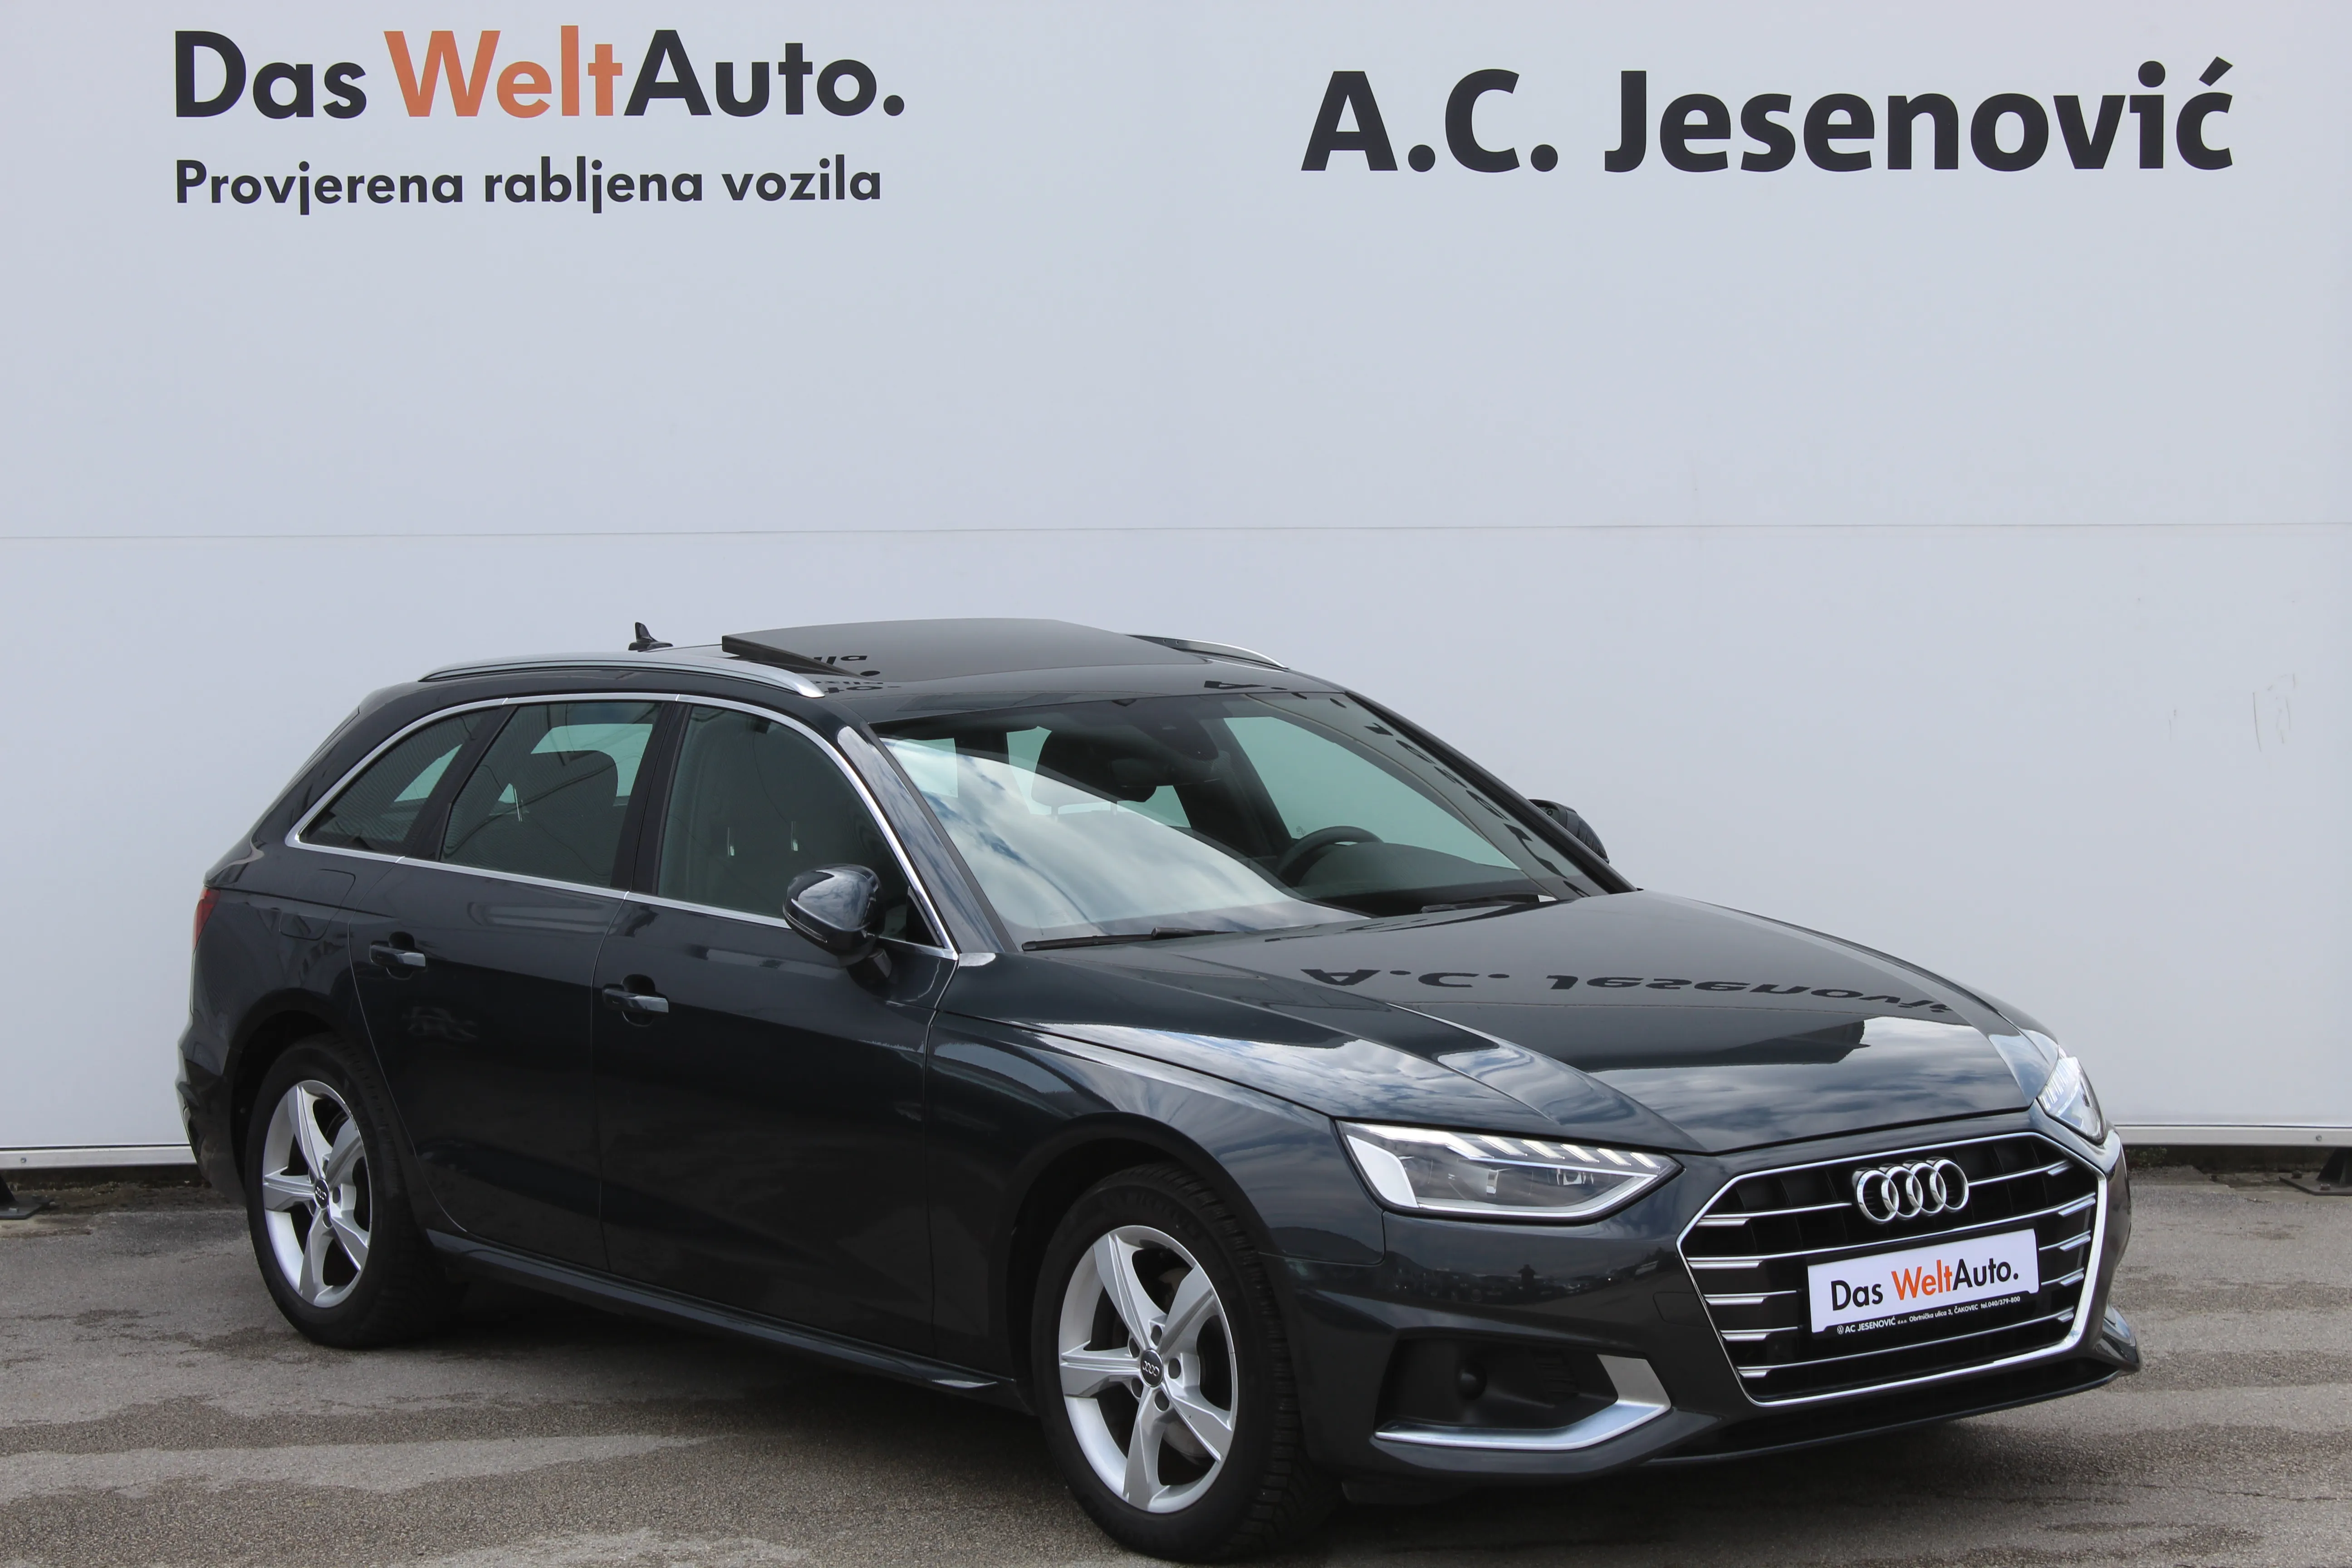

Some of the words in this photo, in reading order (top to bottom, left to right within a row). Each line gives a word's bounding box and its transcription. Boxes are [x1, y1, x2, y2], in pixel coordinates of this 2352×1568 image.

[175, 30, 367, 119] Das
[384, 25, 905, 118] WeltAuto.
[1301, 69, 1558, 173] A.C.
[1604, 56, 2233, 173] Jesenović
[176, 160, 463, 216] Provjerena
[485, 156, 702, 214] rabljena
[721, 154, 880, 201] vozila
[1831, 1279, 1883, 1311] Das
[1891, 1258, 2019, 1300] WeltAuto.
[1845, 1325, 1856, 1333] AC
[1857, 1316, 1896, 1331] JESENOVIĆ
[1909, 1313, 1934, 1322] Obrtnička
[1954, 1304, 1978, 1313] ČAKOVEC
